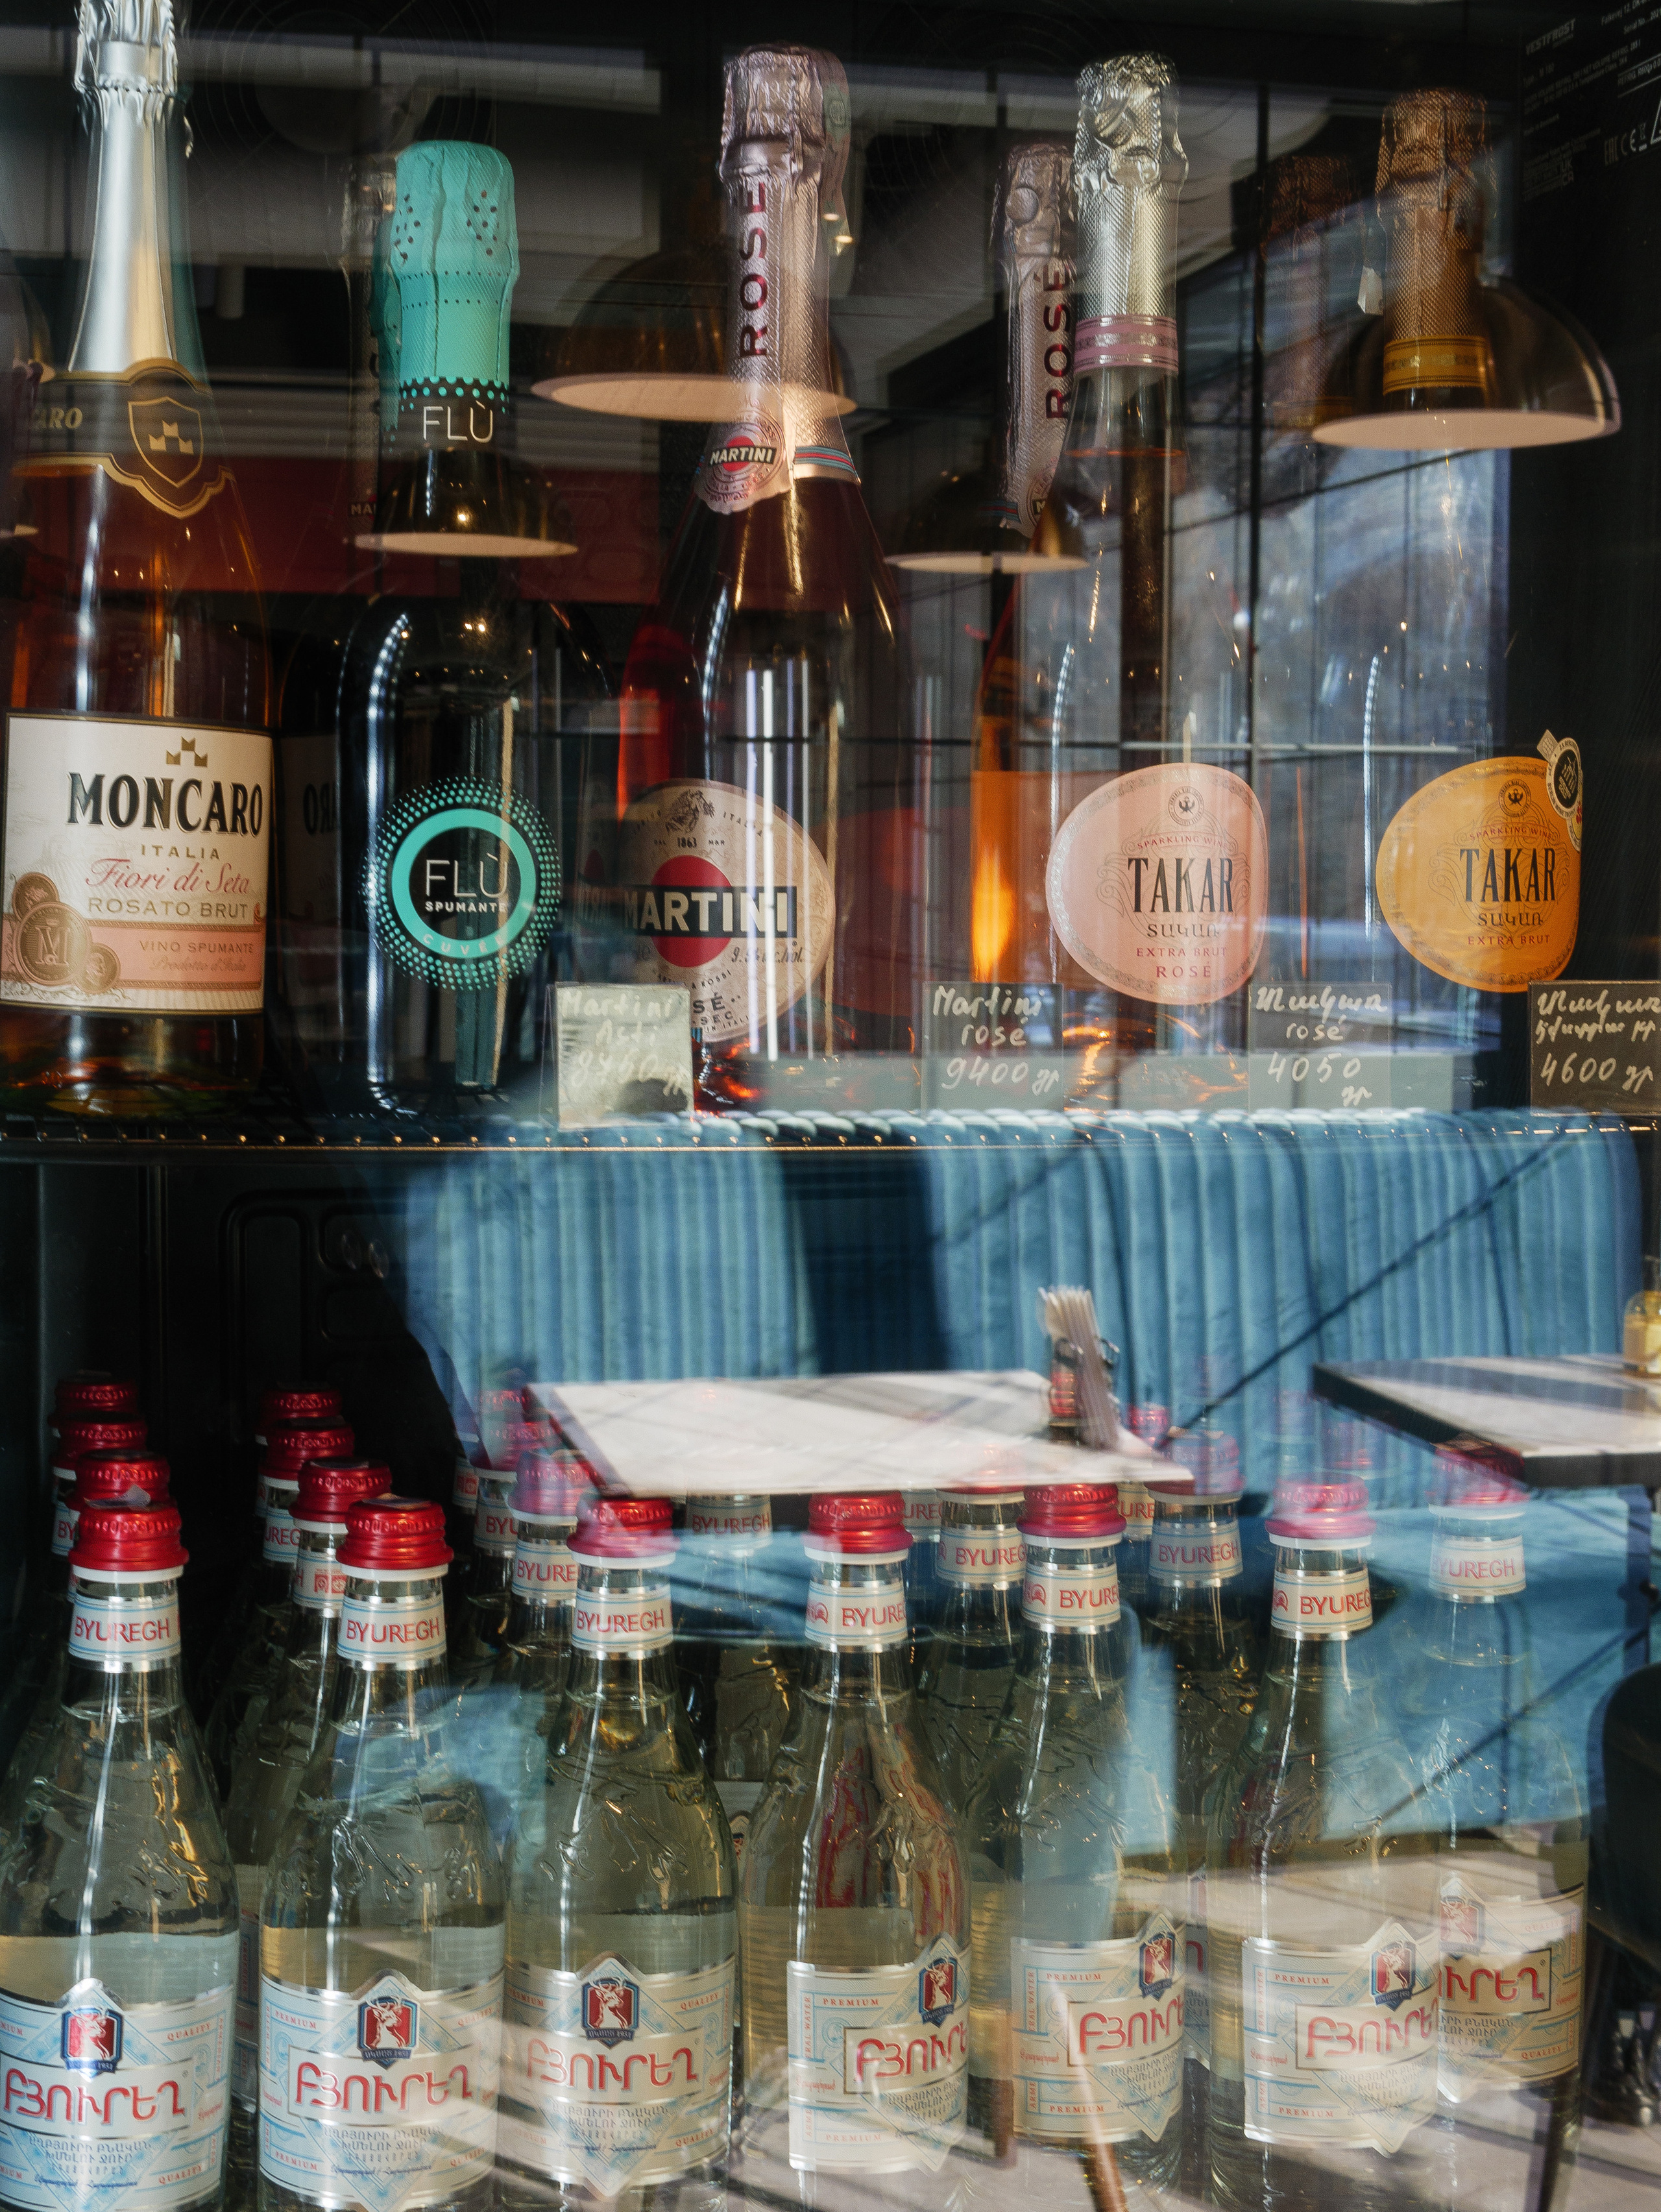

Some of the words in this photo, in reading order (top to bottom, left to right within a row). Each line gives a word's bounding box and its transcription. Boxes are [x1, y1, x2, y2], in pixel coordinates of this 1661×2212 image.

[422, 401, 495, 443] FLÙ
[709, 446, 773, 466] MARTINI
[67, 772, 263, 838] MONCARO
[677, 836, 697, 848] 1863
[1137, 835, 1200, 850] SPARKLING
[1469, 827, 1527, 842] SPARKLING
[141, 844, 220, 860] ITALIA
[86, 858, 170, 892] Fiori
[174, 862, 202, 892] di
[206, 862, 250, 894] Seta
[425, 852, 508, 899] FLÙ
[1128, 857, 1234, 914] TAKAR
[1459, 848, 1557, 903] TAKAR
[89, 897, 190, 917] ROSATO
[200, 902, 249, 919] BRUT
[425, 901, 508, 914] SPUMANTE
[624, 892, 788, 932] MARTINI
[139, 940, 181, 953] VINO
[188, 942, 254, 954] SPUMANTE
[1468, 936, 1514, 946] EXTRA
[1520, 934, 1551, 944] BRUT
[1136, 947, 1186, 957] EXTRA
[1193, 947, 1227, 956] BRUT
[1156, 962, 1212, 978] ROSÉ
[561, 989, 673, 1019] Martini
[932, 985, 1043, 1019] Martini
[941, 1056, 1030, 1089] 9400
[1267, 1051, 1363, 1083] 4050
[1540, 1052, 1617, 1087] 4600
[692, 1511, 771, 1534] BYUREGH
[1159, 1540, 1239, 1564] BYUREGH
[74, 1614, 170, 1644] BYUREGH
[346, 1616, 440, 1644] BYUREGH
[577, 1609, 665, 1634] BYUREGH
[1046, 1973, 1102, 1981] PREMIUM
[1274, 1973, 1330, 1984] PREMIUM
[680, 1992, 720, 2011] QUALITY
[823, 1997, 880, 2007] PREMIUM
[274, 2010, 318, 2030] PREMIUM
[167, 2021, 212, 2042] QUALITY
[1049, 2104, 1104, 2114] PREMIUM
[1278, 2106, 1335, 2118] PREMIUM
[675, 2128, 714, 2148] QUALITY
[825, 2132, 882, 2143] PREMIUM
[274, 2150, 318, 2171] PREMIUM
[158, 2165, 203, 2185] QUALITY
